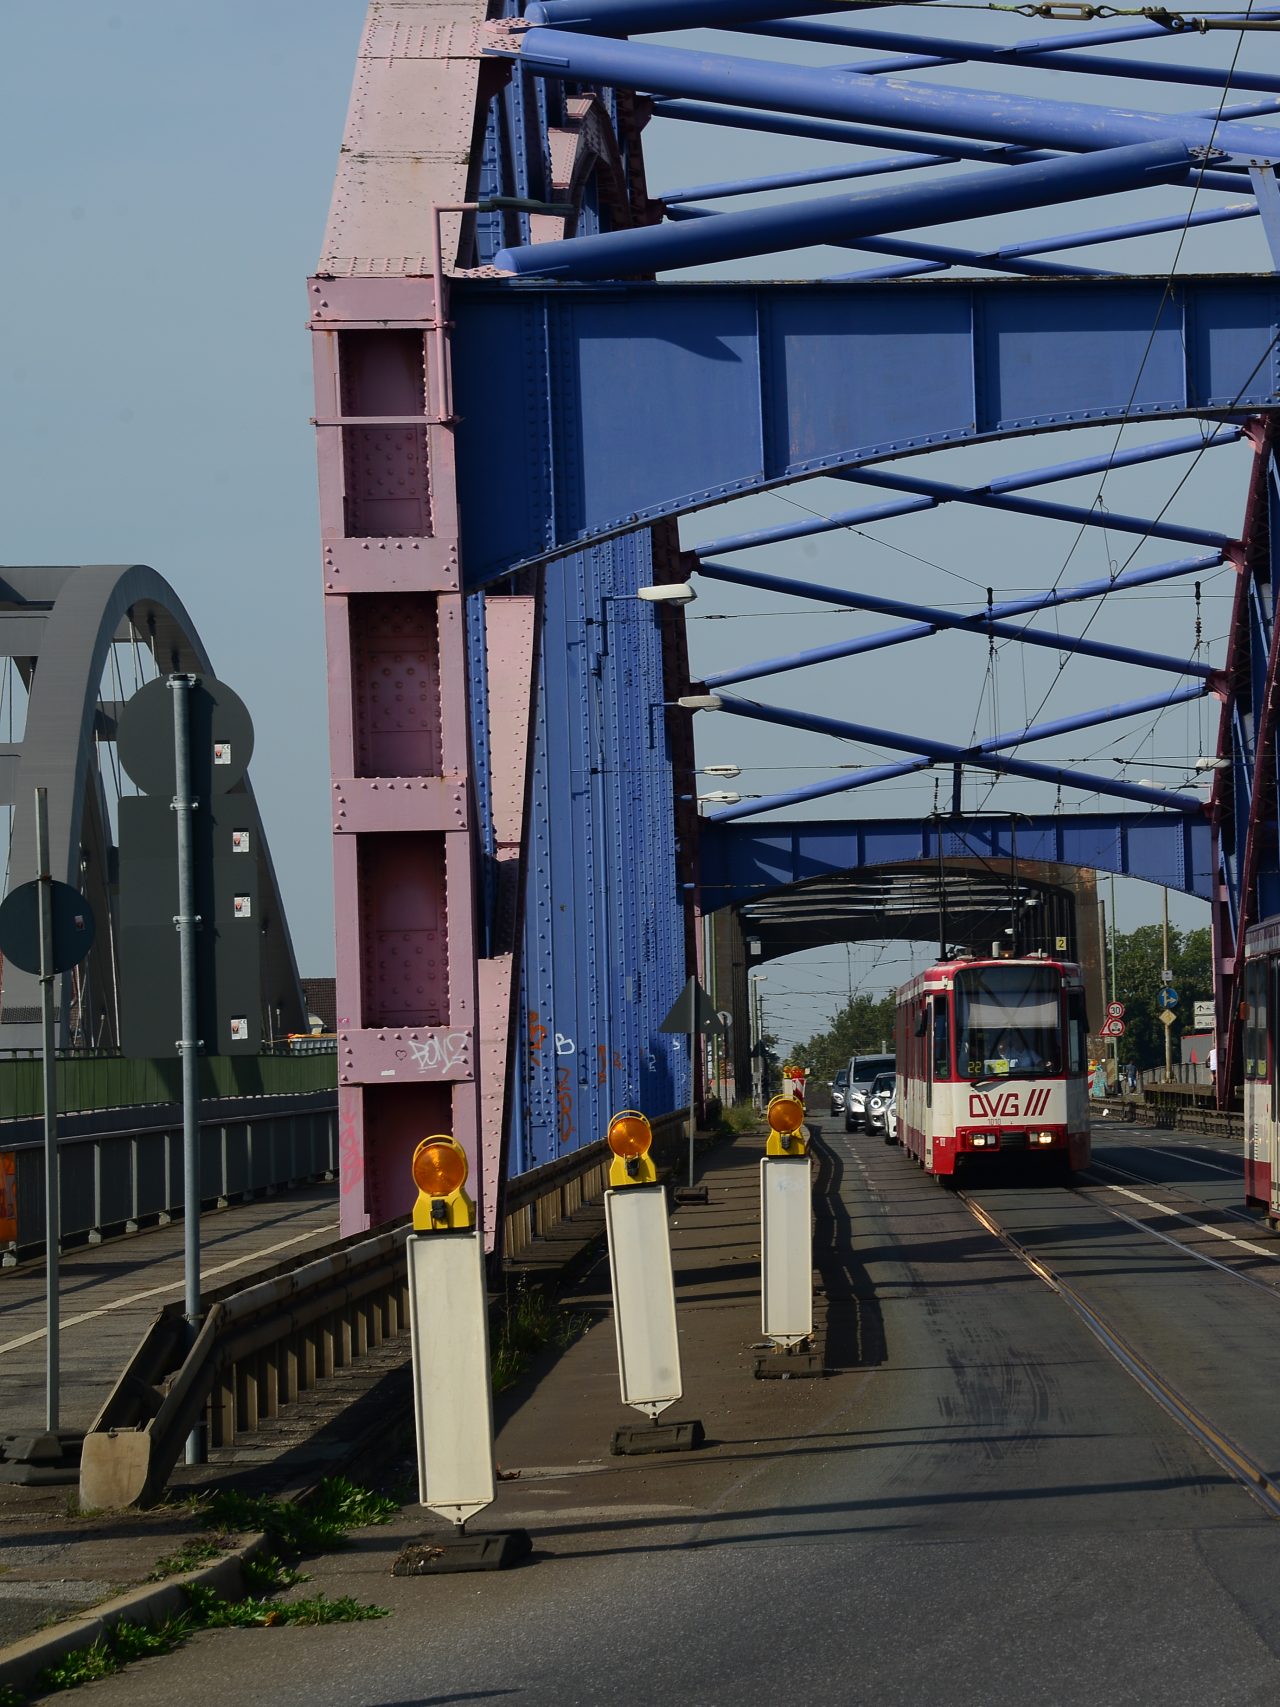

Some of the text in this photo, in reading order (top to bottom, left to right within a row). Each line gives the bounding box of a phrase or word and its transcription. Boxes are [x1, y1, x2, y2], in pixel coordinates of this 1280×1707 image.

[1058, 939, 1064, 948] 2
[968, 1061, 982, 1073] 22
[969, 1093, 1019, 1117] DVG
